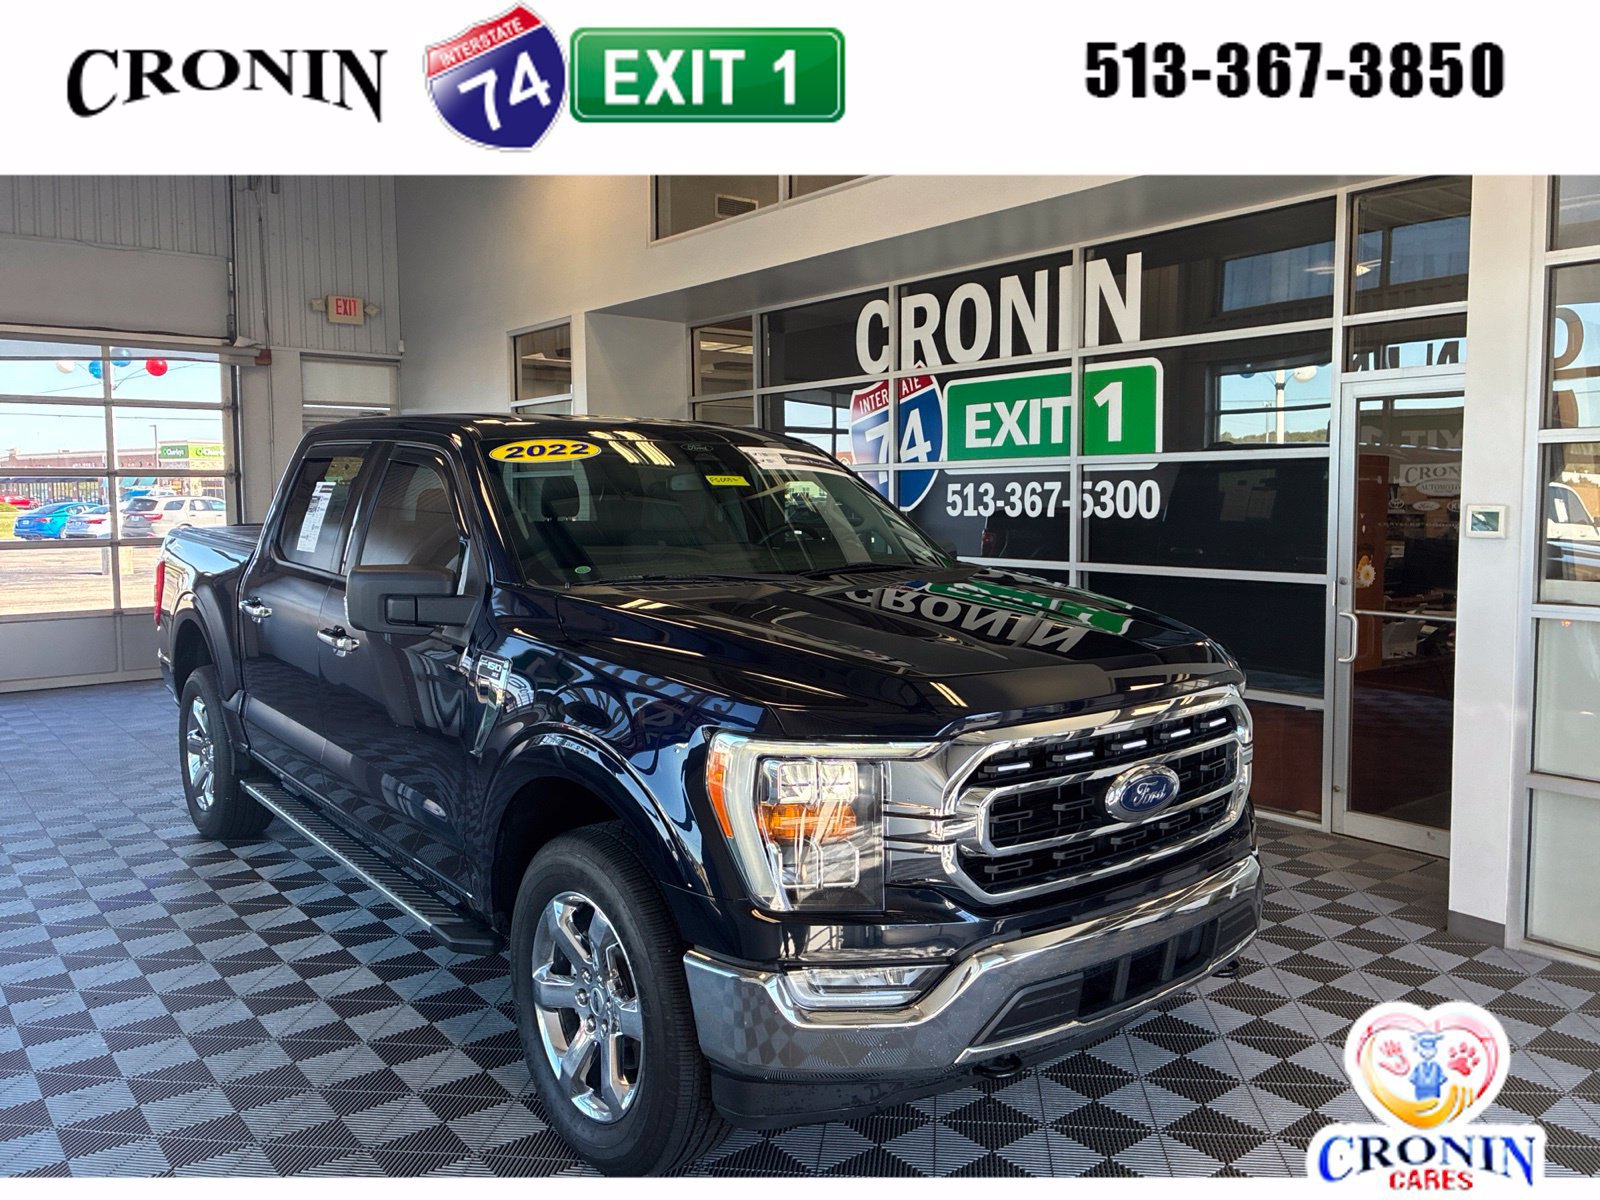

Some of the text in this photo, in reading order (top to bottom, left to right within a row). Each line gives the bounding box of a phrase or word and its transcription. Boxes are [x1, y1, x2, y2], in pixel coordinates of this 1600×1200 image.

[335, 297, 358, 317] EXIT
[856, 252, 1143, 374] CRONIN
[859, 376, 922, 415] INTERATE
[965, 381, 1123, 449] EXIT 1
[504, 443, 590, 459] 2022
[865, 408, 932, 485] 74
[1404, 465, 1462, 484] CRON
[946, 479, 1161, 519] 513-367-5300
[1133, 780, 1167, 807] Ford
